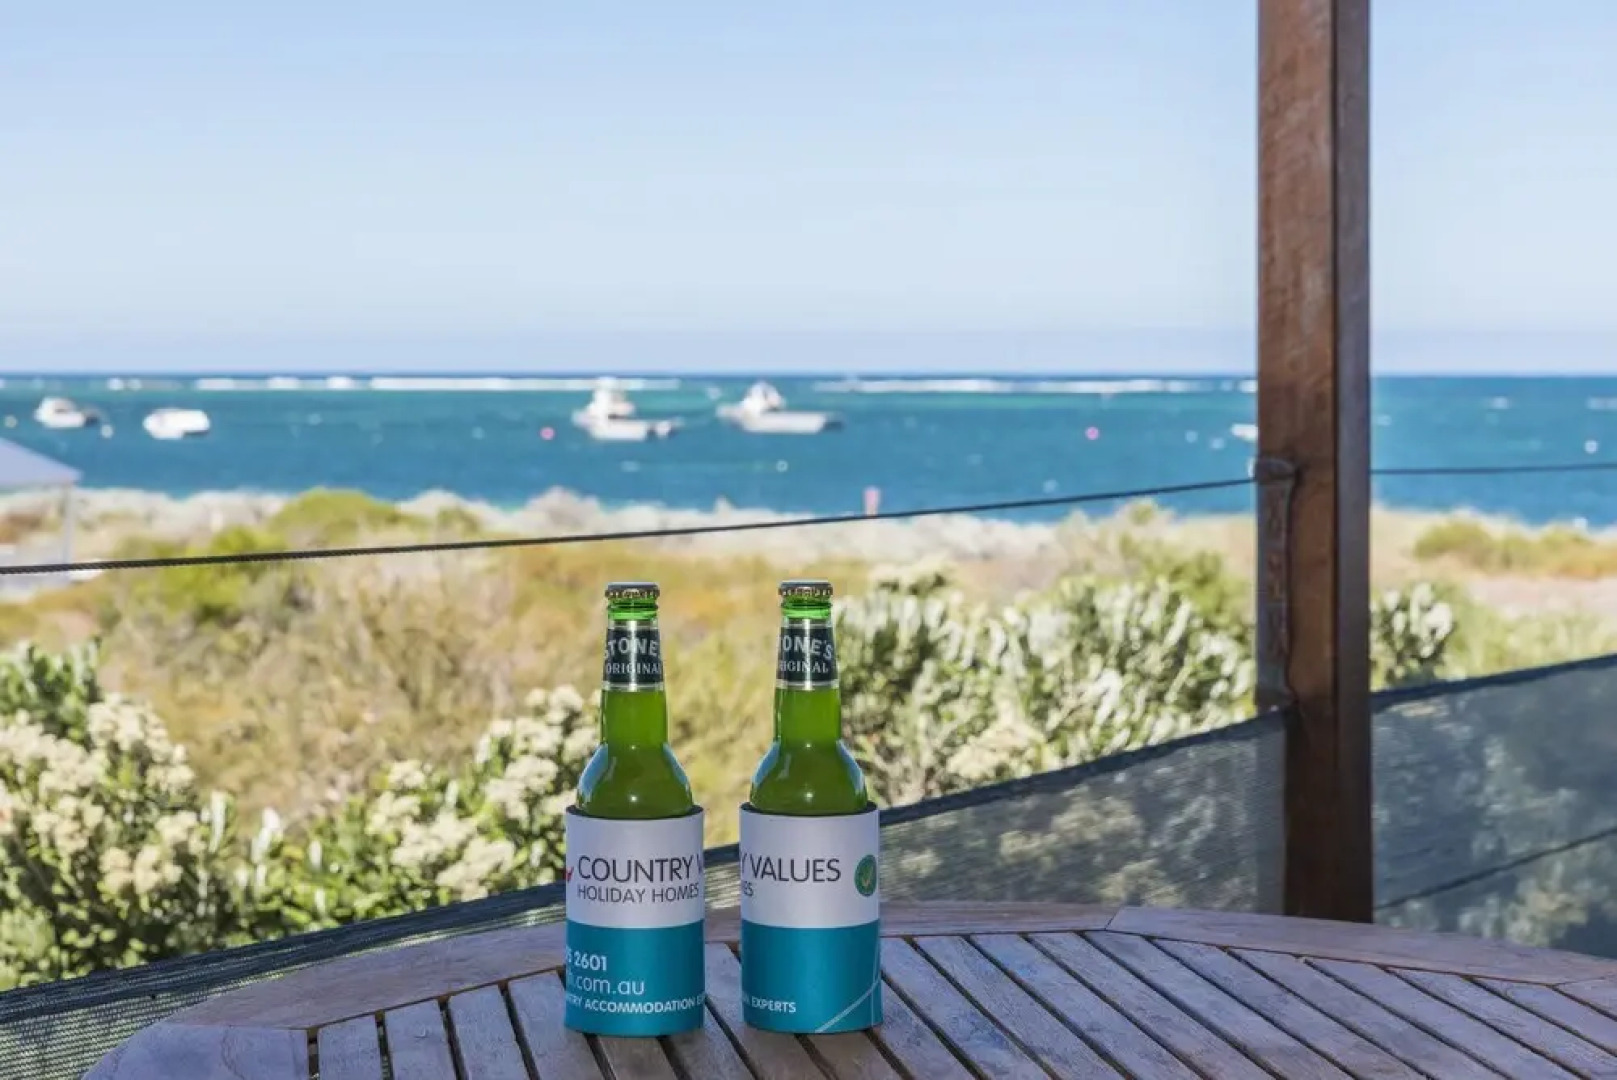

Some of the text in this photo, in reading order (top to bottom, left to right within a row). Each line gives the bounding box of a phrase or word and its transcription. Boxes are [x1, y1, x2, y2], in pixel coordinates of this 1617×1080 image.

[779, 634, 833, 660] ONE'S
[578, 855, 693, 882] COUNTRY
[749, 854, 841, 882] VALUES
[578, 882, 699, 903] HOLIDAY HOMES
[574, 951, 608, 971] 2601
[577, 976, 645, 995] com.au
[584, 998, 695, 1014] ACCOMMODATION
[751, 995, 797, 1013] EXPERTS
